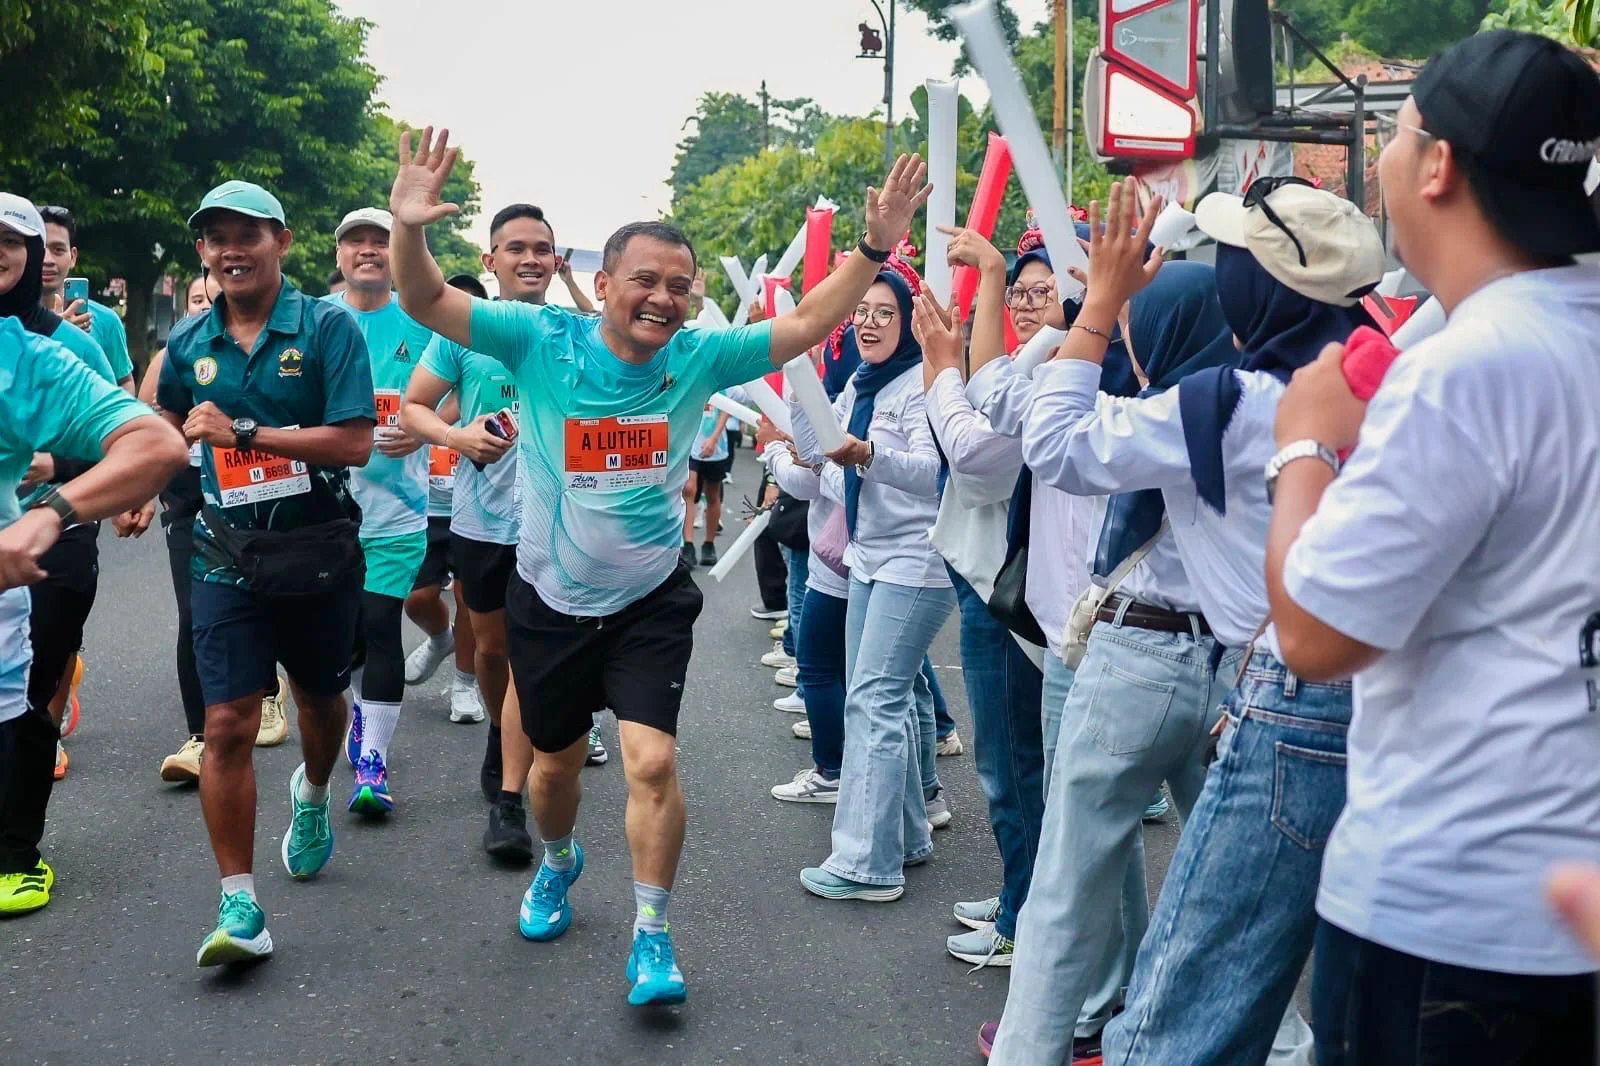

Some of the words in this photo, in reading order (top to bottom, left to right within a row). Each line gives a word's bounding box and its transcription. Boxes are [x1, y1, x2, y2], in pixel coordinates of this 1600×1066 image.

[501, 384, 519, 399] MI
[376, 399, 391, 412] EN
[389, 416, 397, 425] M
[581, 432, 592, 451] A
[597, 429, 652, 450] LUTHFI
[224, 446, 291, 469] RAMAZ
[609, 455, 618, 468] M
[624, 453, 649, 467] 5541
[655, 452, 664, 464] M
[253, 469, 261, 481] M
[265, 463, 290, 479] 6698
[573, 474, 595, 484] RUN
